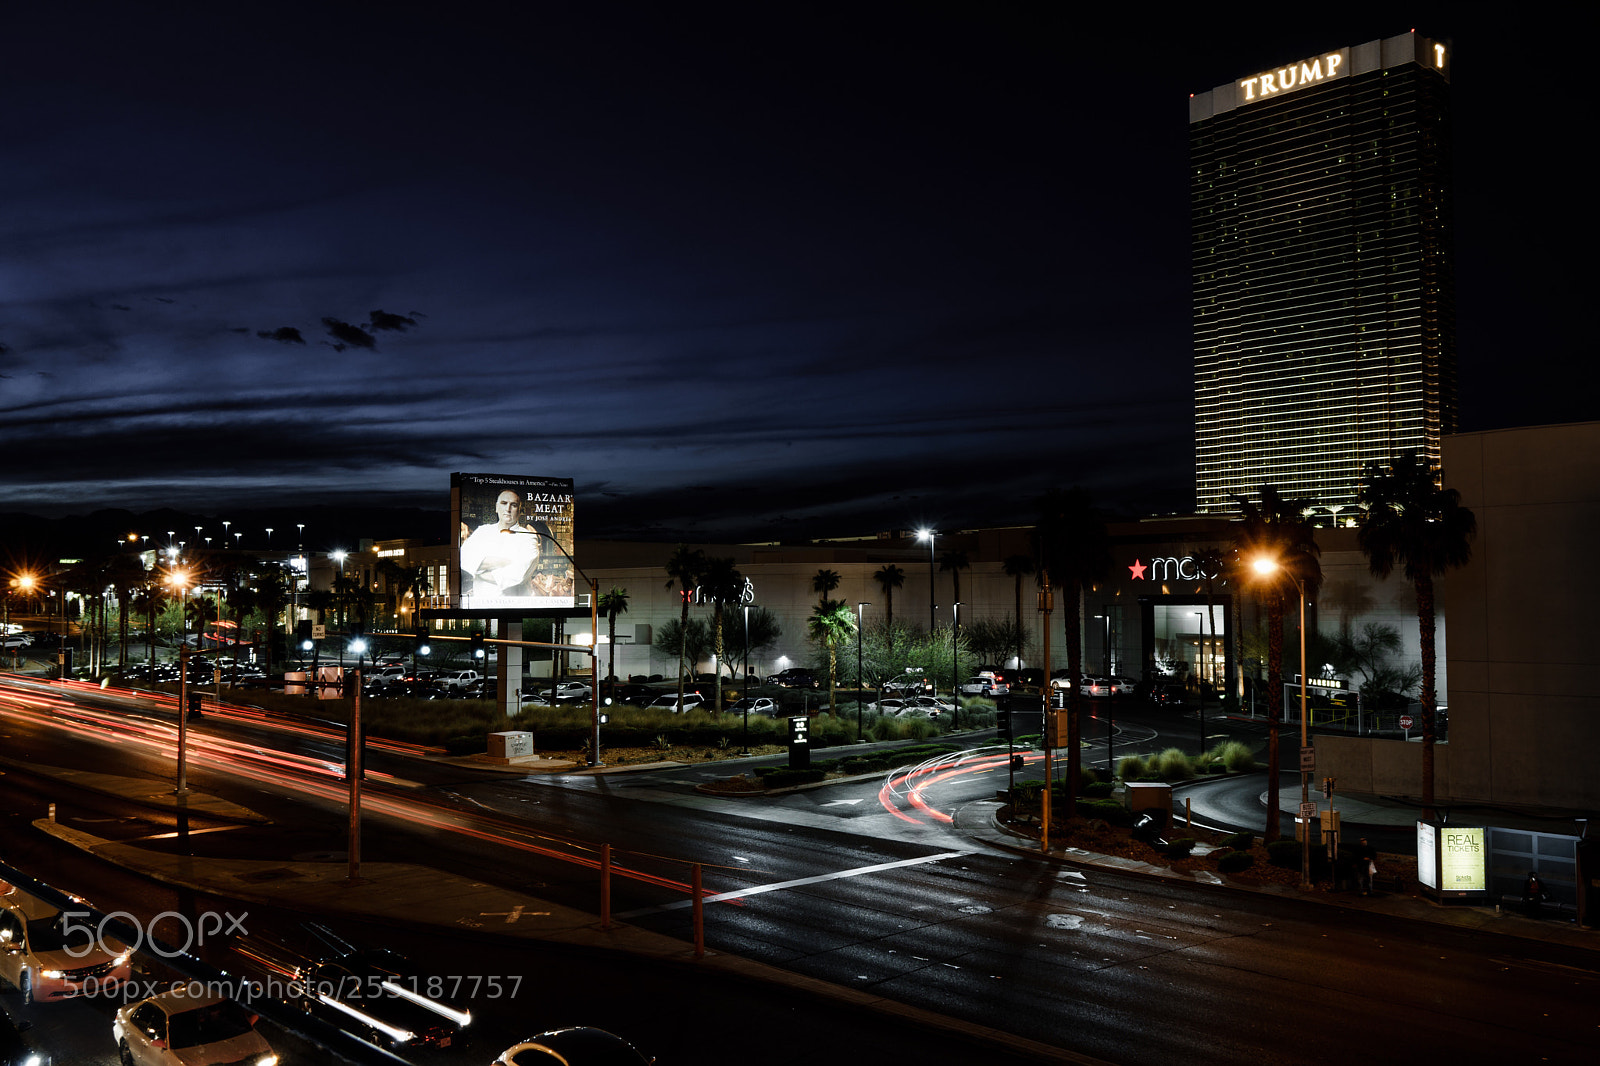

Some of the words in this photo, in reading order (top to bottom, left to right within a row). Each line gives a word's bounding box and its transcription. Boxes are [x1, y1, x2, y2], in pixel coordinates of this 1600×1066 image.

[1240, 53, 1342, 101] TRUMP
[526, 492, 571, 502] BAZAAR
[534, 504, 564, 514] MEAT
[1308, 678, 1342, 688] PARKING
[1447, 834, 1480, 846] REAL
